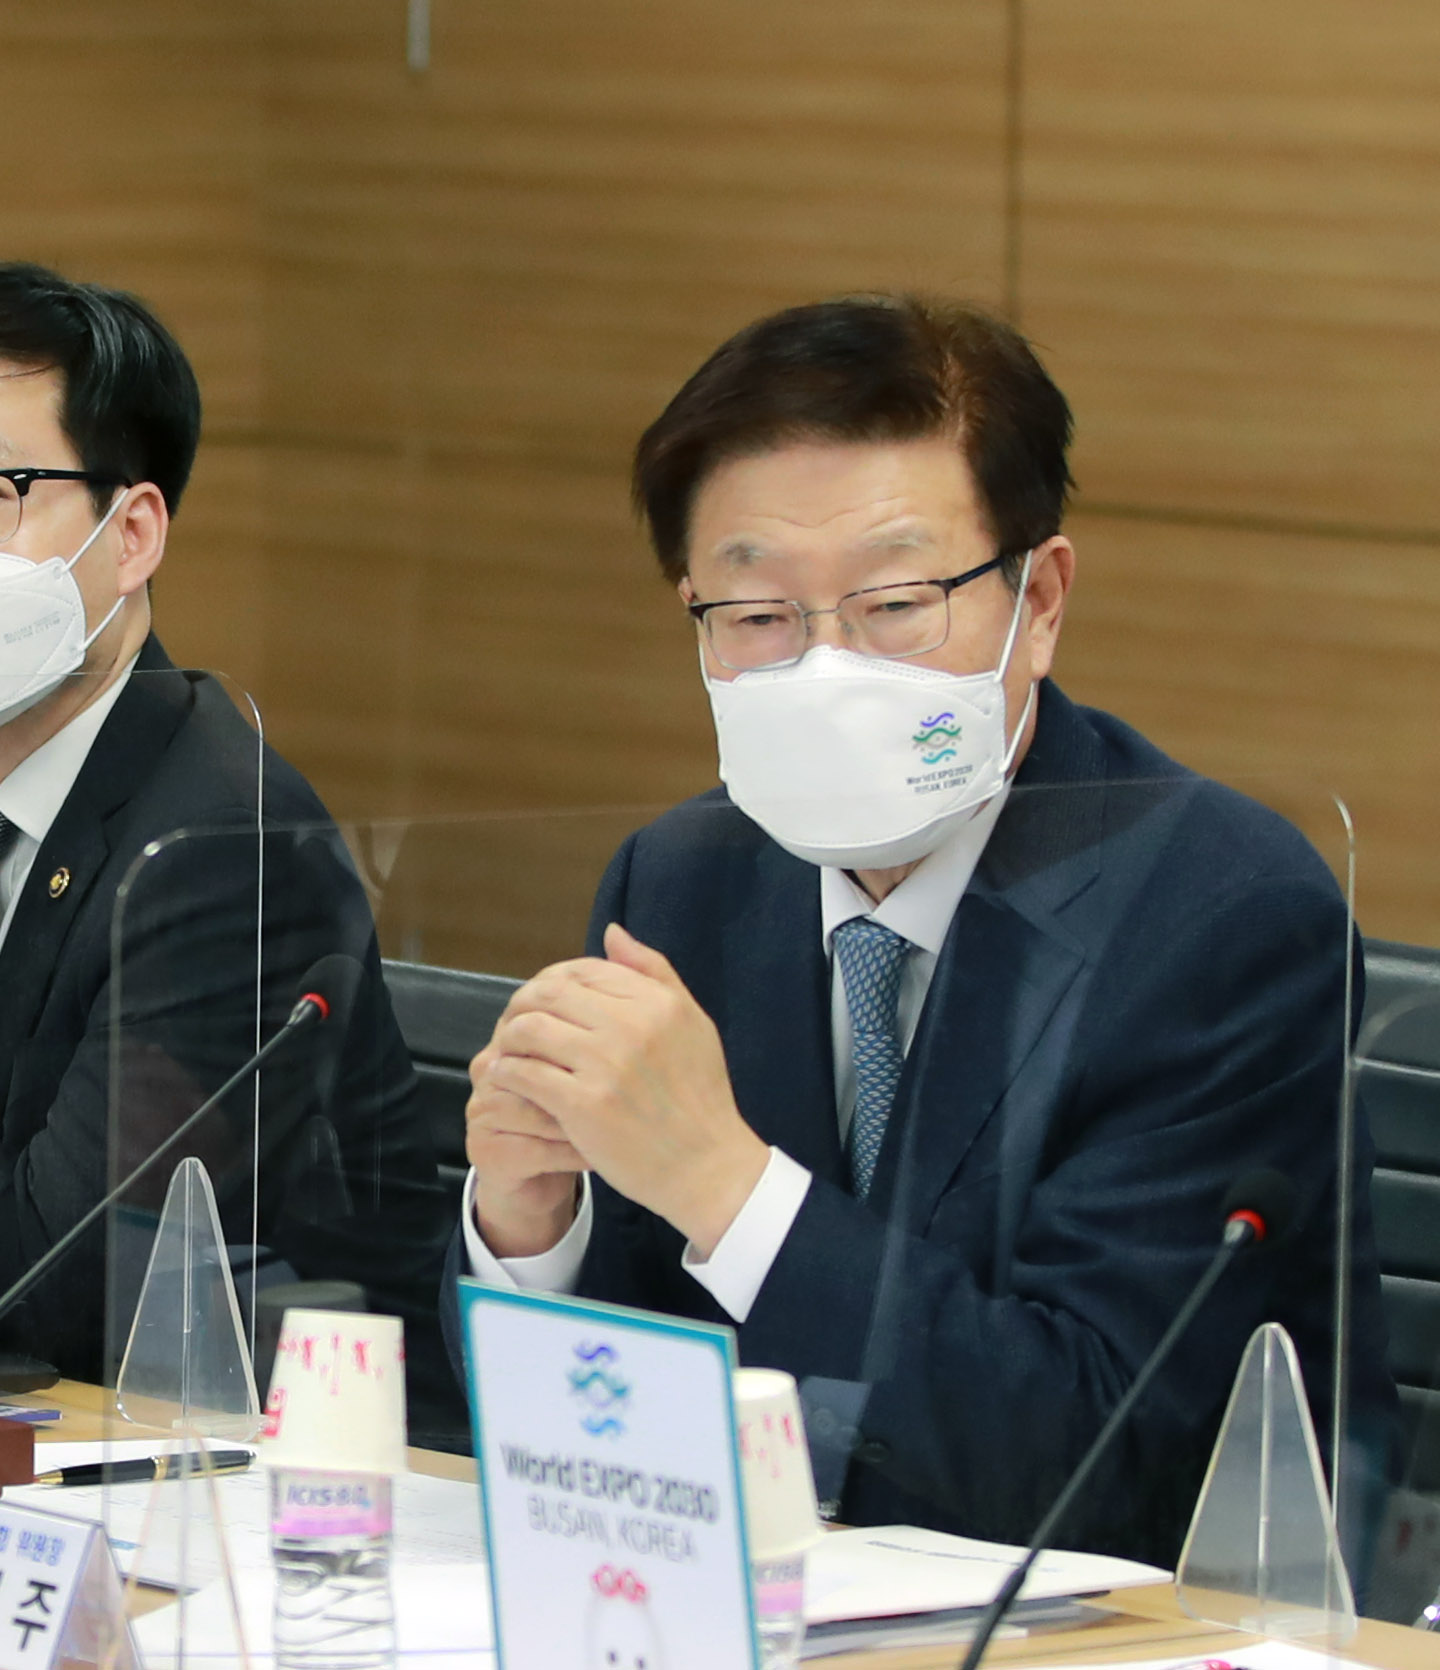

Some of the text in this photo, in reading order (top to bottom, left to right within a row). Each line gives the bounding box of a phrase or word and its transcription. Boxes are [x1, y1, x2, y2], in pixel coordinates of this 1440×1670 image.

[500, 1442, 720, 1525] World EXPO 2030
[16, 1530, 66, 1567] 위원장
[526, 1493, 698, 1564] BUSAN, KOREA
